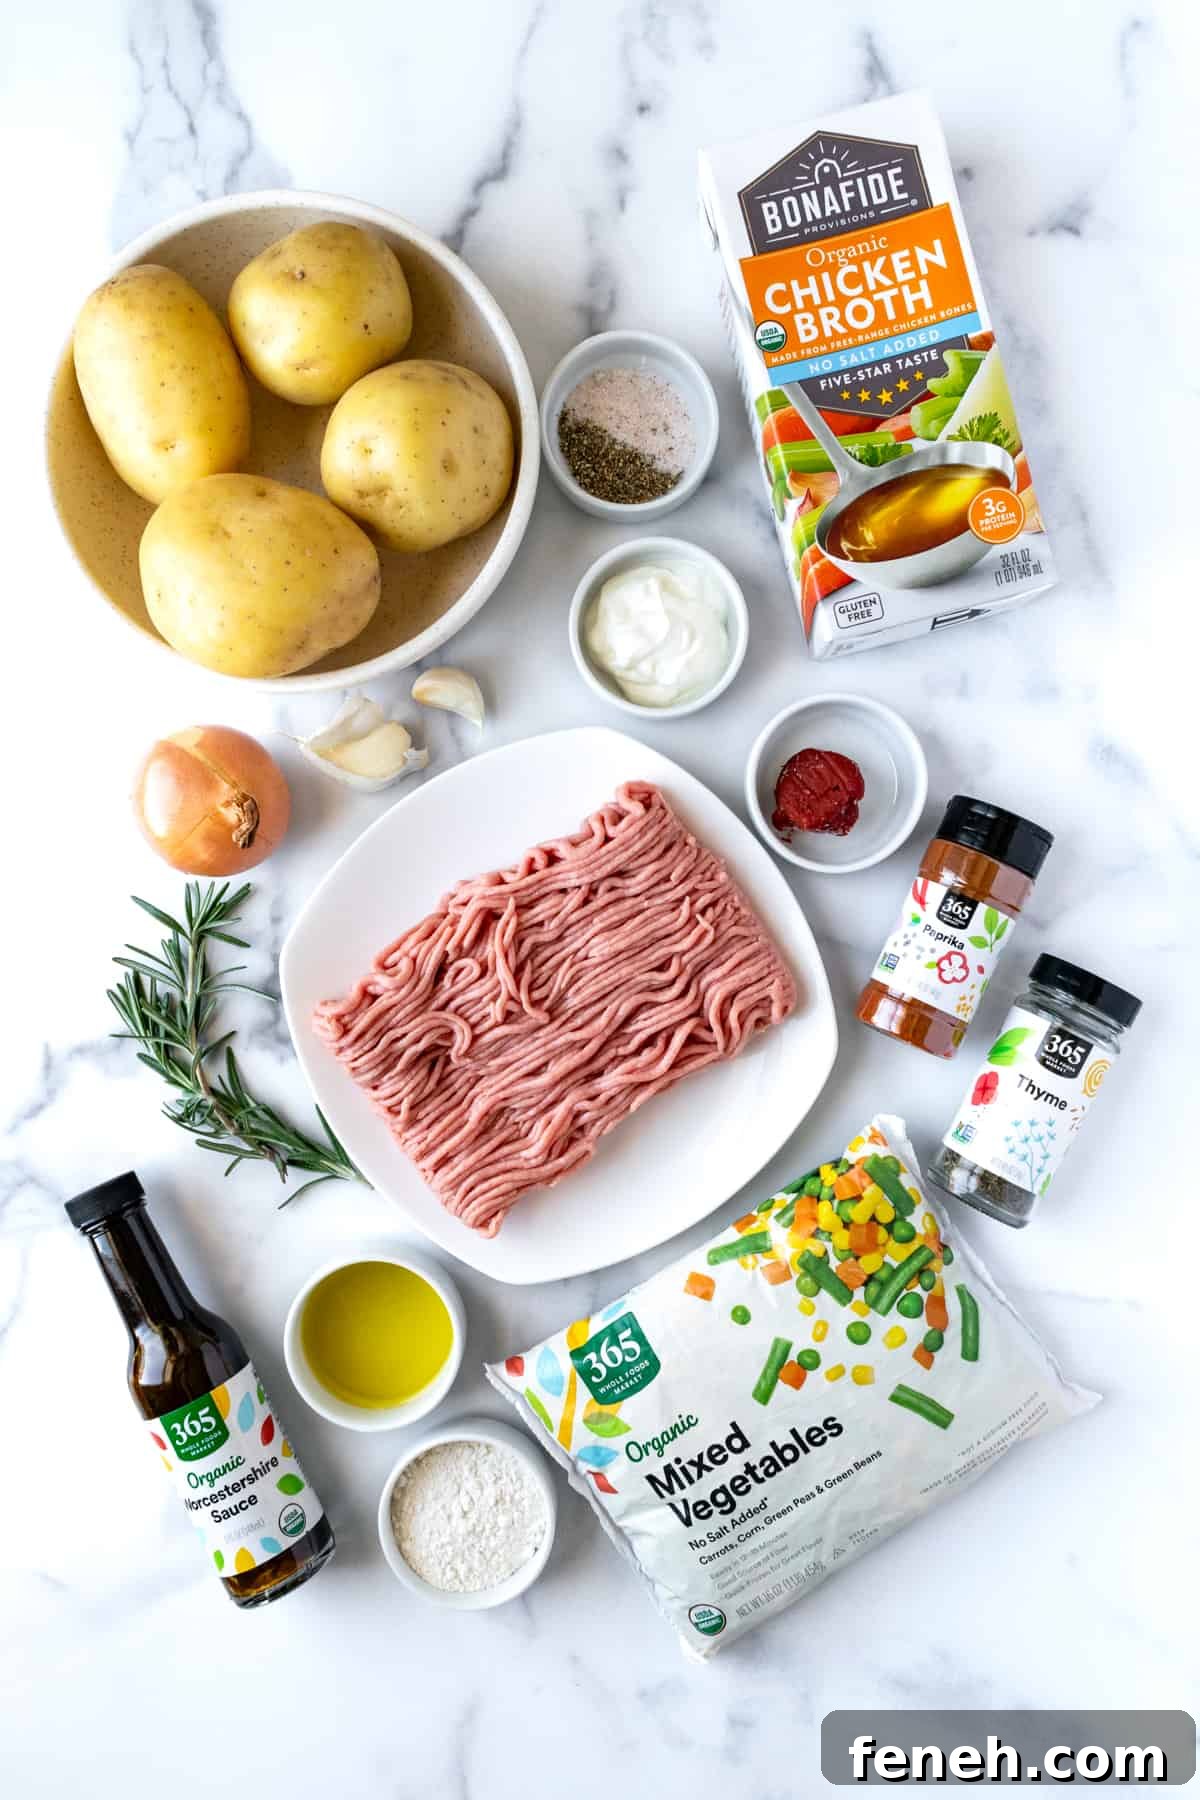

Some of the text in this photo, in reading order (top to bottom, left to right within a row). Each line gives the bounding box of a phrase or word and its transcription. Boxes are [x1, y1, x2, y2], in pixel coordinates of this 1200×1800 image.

[761, 167, 908, 235] BONAFIDE
[804, 210, 876, 235] PROVISIONS
[805, 234, 889, 267] Organic
[764, 239, 947, 314] CHICKEN
[794, 279, 934, 344] BROTH
[771, 302, 973, 364] MADE FROM FREE-RANGE CHICKEN BONES
[808, 330, 941, 375] NO SALT ADDED
[819, 348, 940, 391] FIVE-STAR TASTE
[981, 498, 1007, 516] 3G
[838, 597, 877, 615] GLUTEN
[847, 609, 873, 622] FREE
[941, 897, 973, 920] 365
[922, 924, 965, 950] Paprika
[1045, 1034, 1086, 1065] 365
[1018, 1074, 1068, 1111] Thyme
[581, 1327, 641, 1384] 365
[598, 1359, 650, 1395] WHOLE FOODS
[612, 1373, 643, 1396] MARKET
[170, 1406, 217, 1446] 365
[625, 1413, 699, 1463] Organic
[186, 1454, 246, 1490] Organic
[645, 1421, 752, 1500] Mixed
[667, 1415, 844, 1528] Vegetables
[210, 1493, 259, 1524] Sauce
[699, 1540, 739, 1565] Carrots,
[737, 1523, 765, 1544] Corn,
[764, 1503, 795, 1526] Green
[793, 1490, 816, 1508] Peas
[815, 1484, 825, 1495] &
[824, 1468, 855, 1489] Green
[853, 1449, 883, 1471] Beans
[688, 1535, 707, 1552] No
[706, 1525, 730, 1544] Salt
